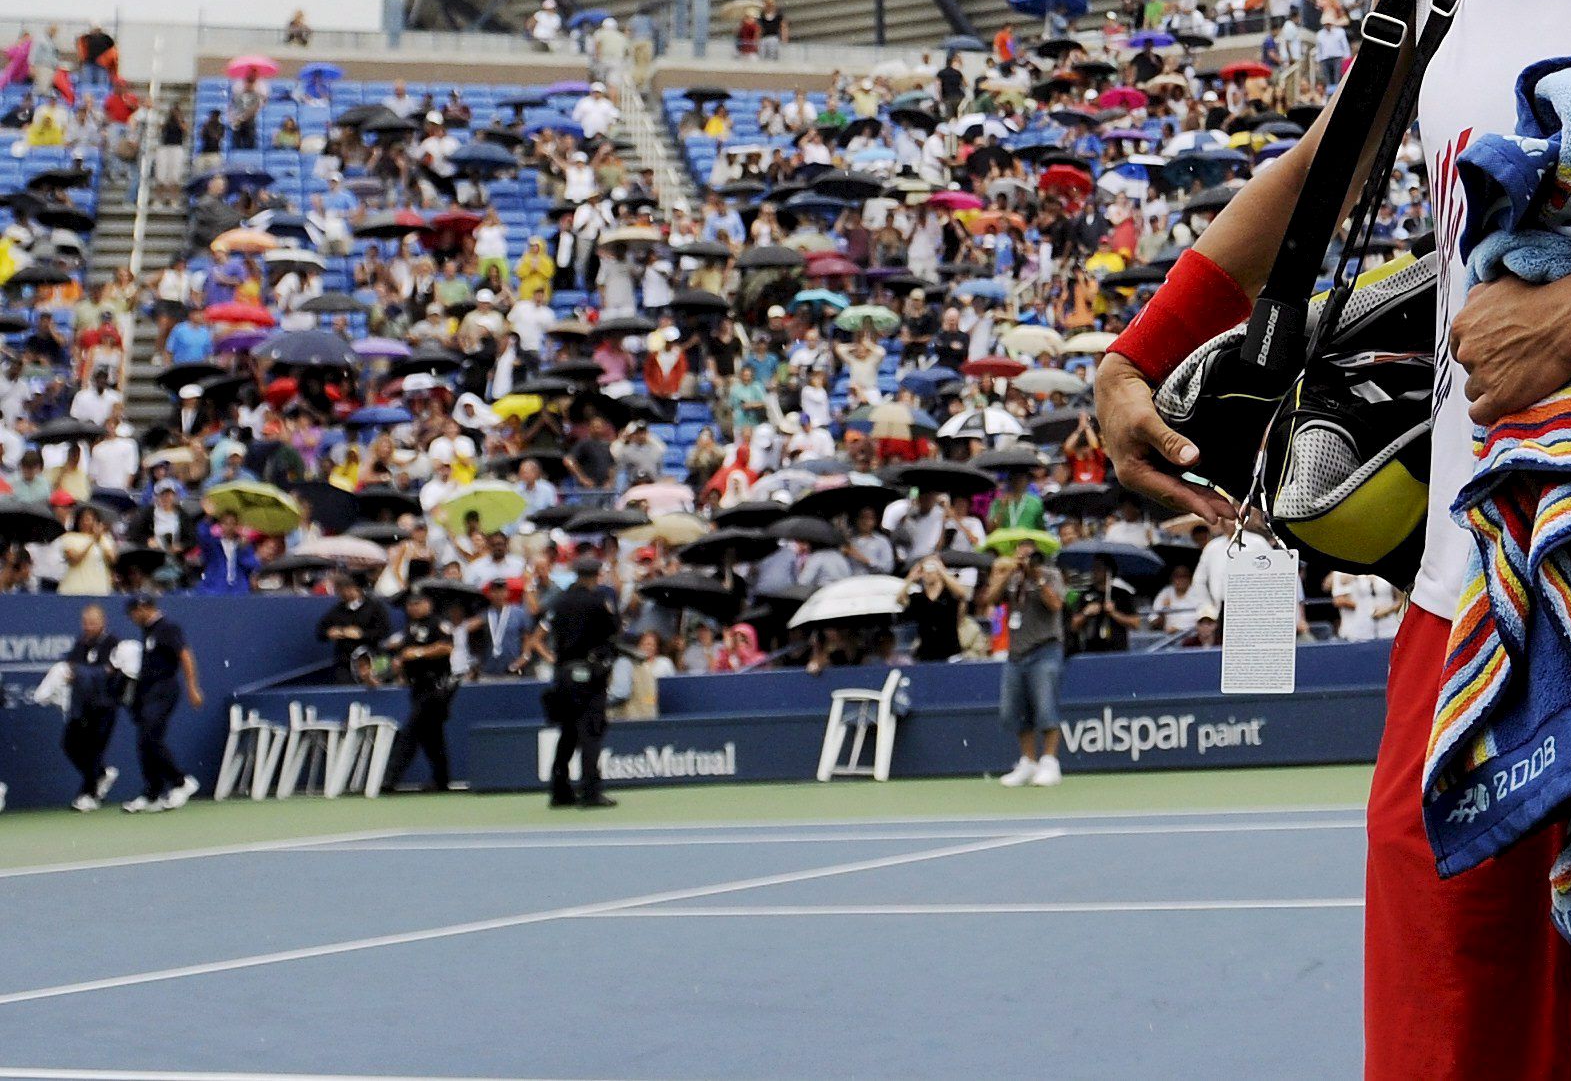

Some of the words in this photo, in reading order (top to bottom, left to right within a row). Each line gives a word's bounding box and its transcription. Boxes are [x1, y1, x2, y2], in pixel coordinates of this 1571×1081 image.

[1257, 305, 1280, 366] Babolat
[1060, 705, 1195, 762] valspar
[1197, 716, 1262, 756] paint
[1493, 735, 1556, 802] 2008
